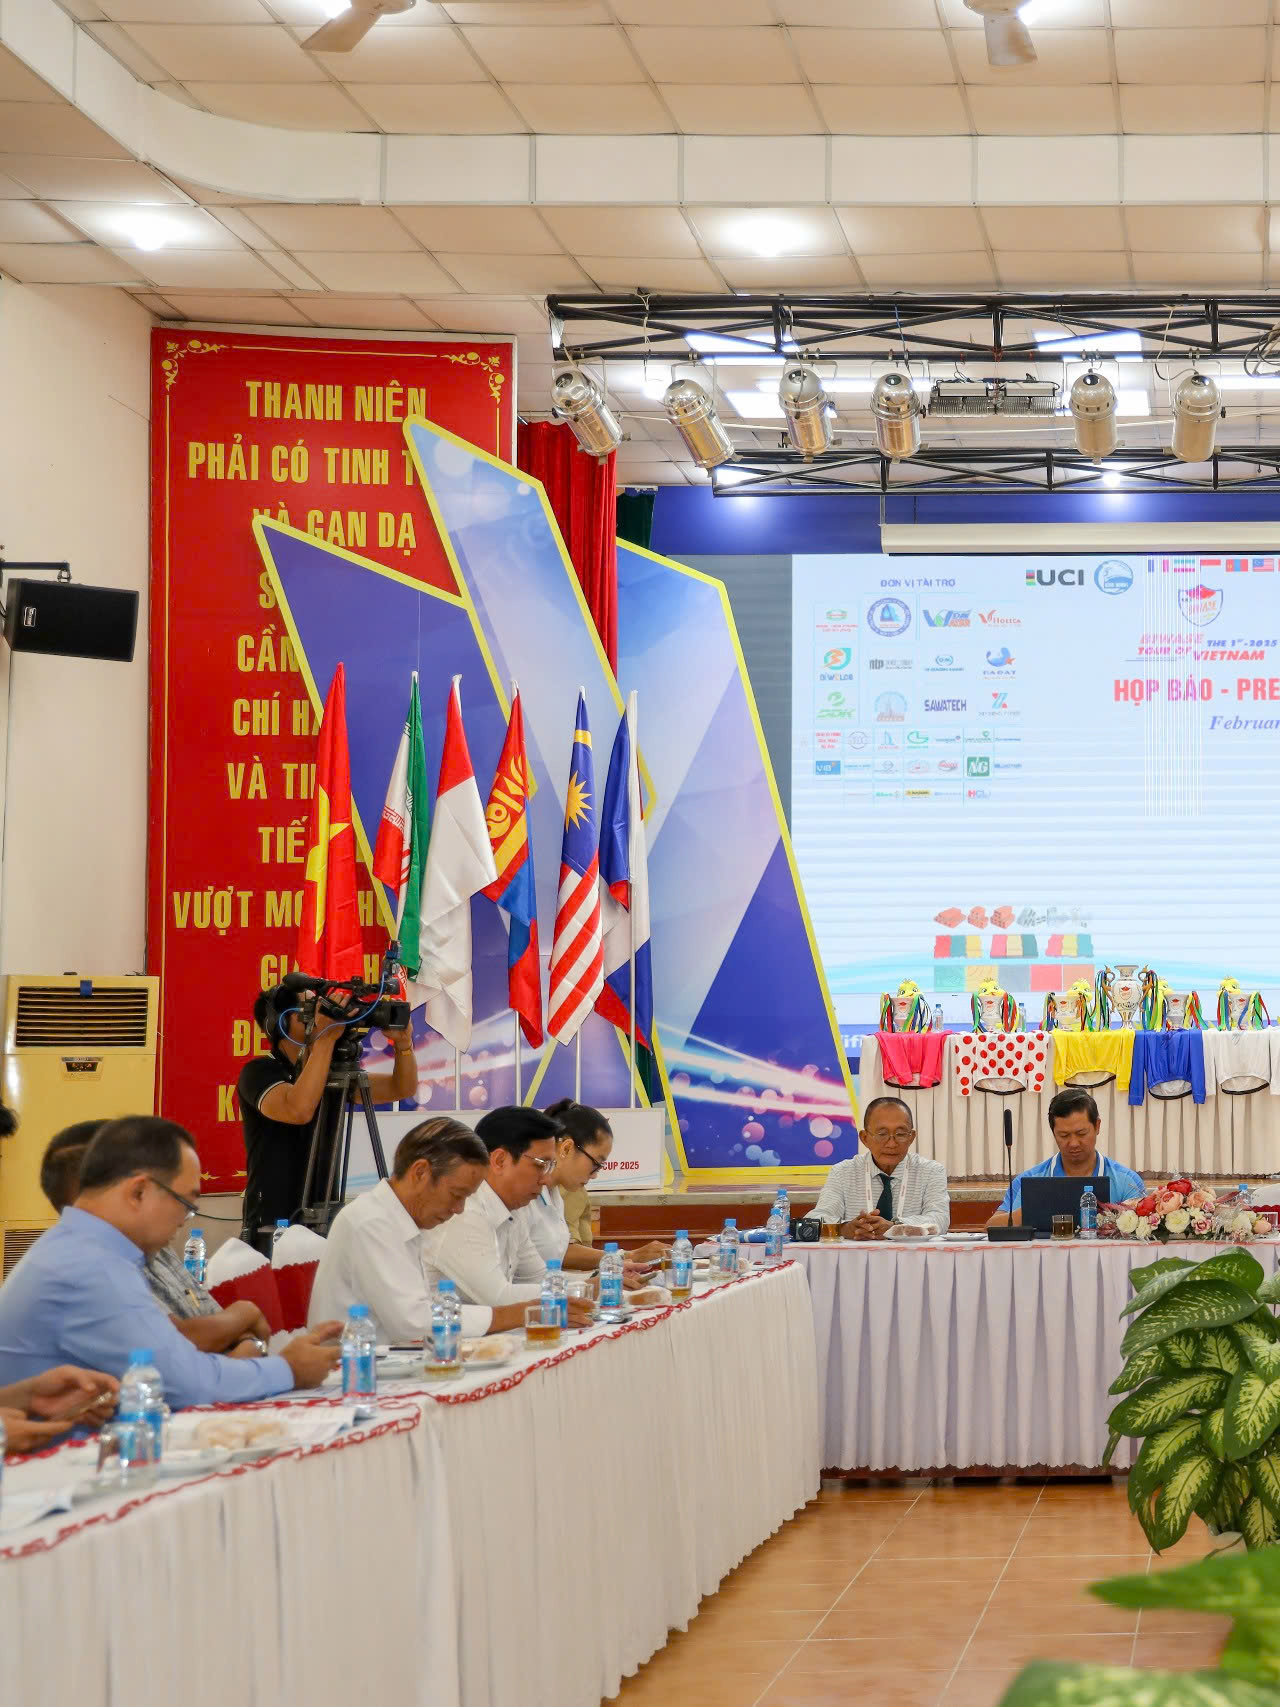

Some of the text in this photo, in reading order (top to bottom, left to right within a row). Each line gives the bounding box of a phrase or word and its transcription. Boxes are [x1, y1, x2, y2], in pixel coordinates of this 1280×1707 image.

[246, 380, 426, 423] THANH NIÊN
[188, 433, 259, 481] PHẢI
[271, 440, 309, 483] CÓ
[324, 447, 389, 485] TINH
[378, 512, 416, 556] DẠ
[1036, 569, 1084, 586] UCI
[1138, 647, 1171, 655] TOUR
[1193, 650, 1265, 661] VIETNAM
[1207, 639, 1226, 647] THE
[925, 699, 967, 712] SAWATECH
[1114, 678, 1160, 706] HỌP
[1167, 674, 1213, 702] BÁO
[233, 692, 280, 736] CHÍ
[226, 755, 267, 799] VÀ
[173, 886, 253, 935] VƯỢT
[620, 1161, 639, 1170] 2025
